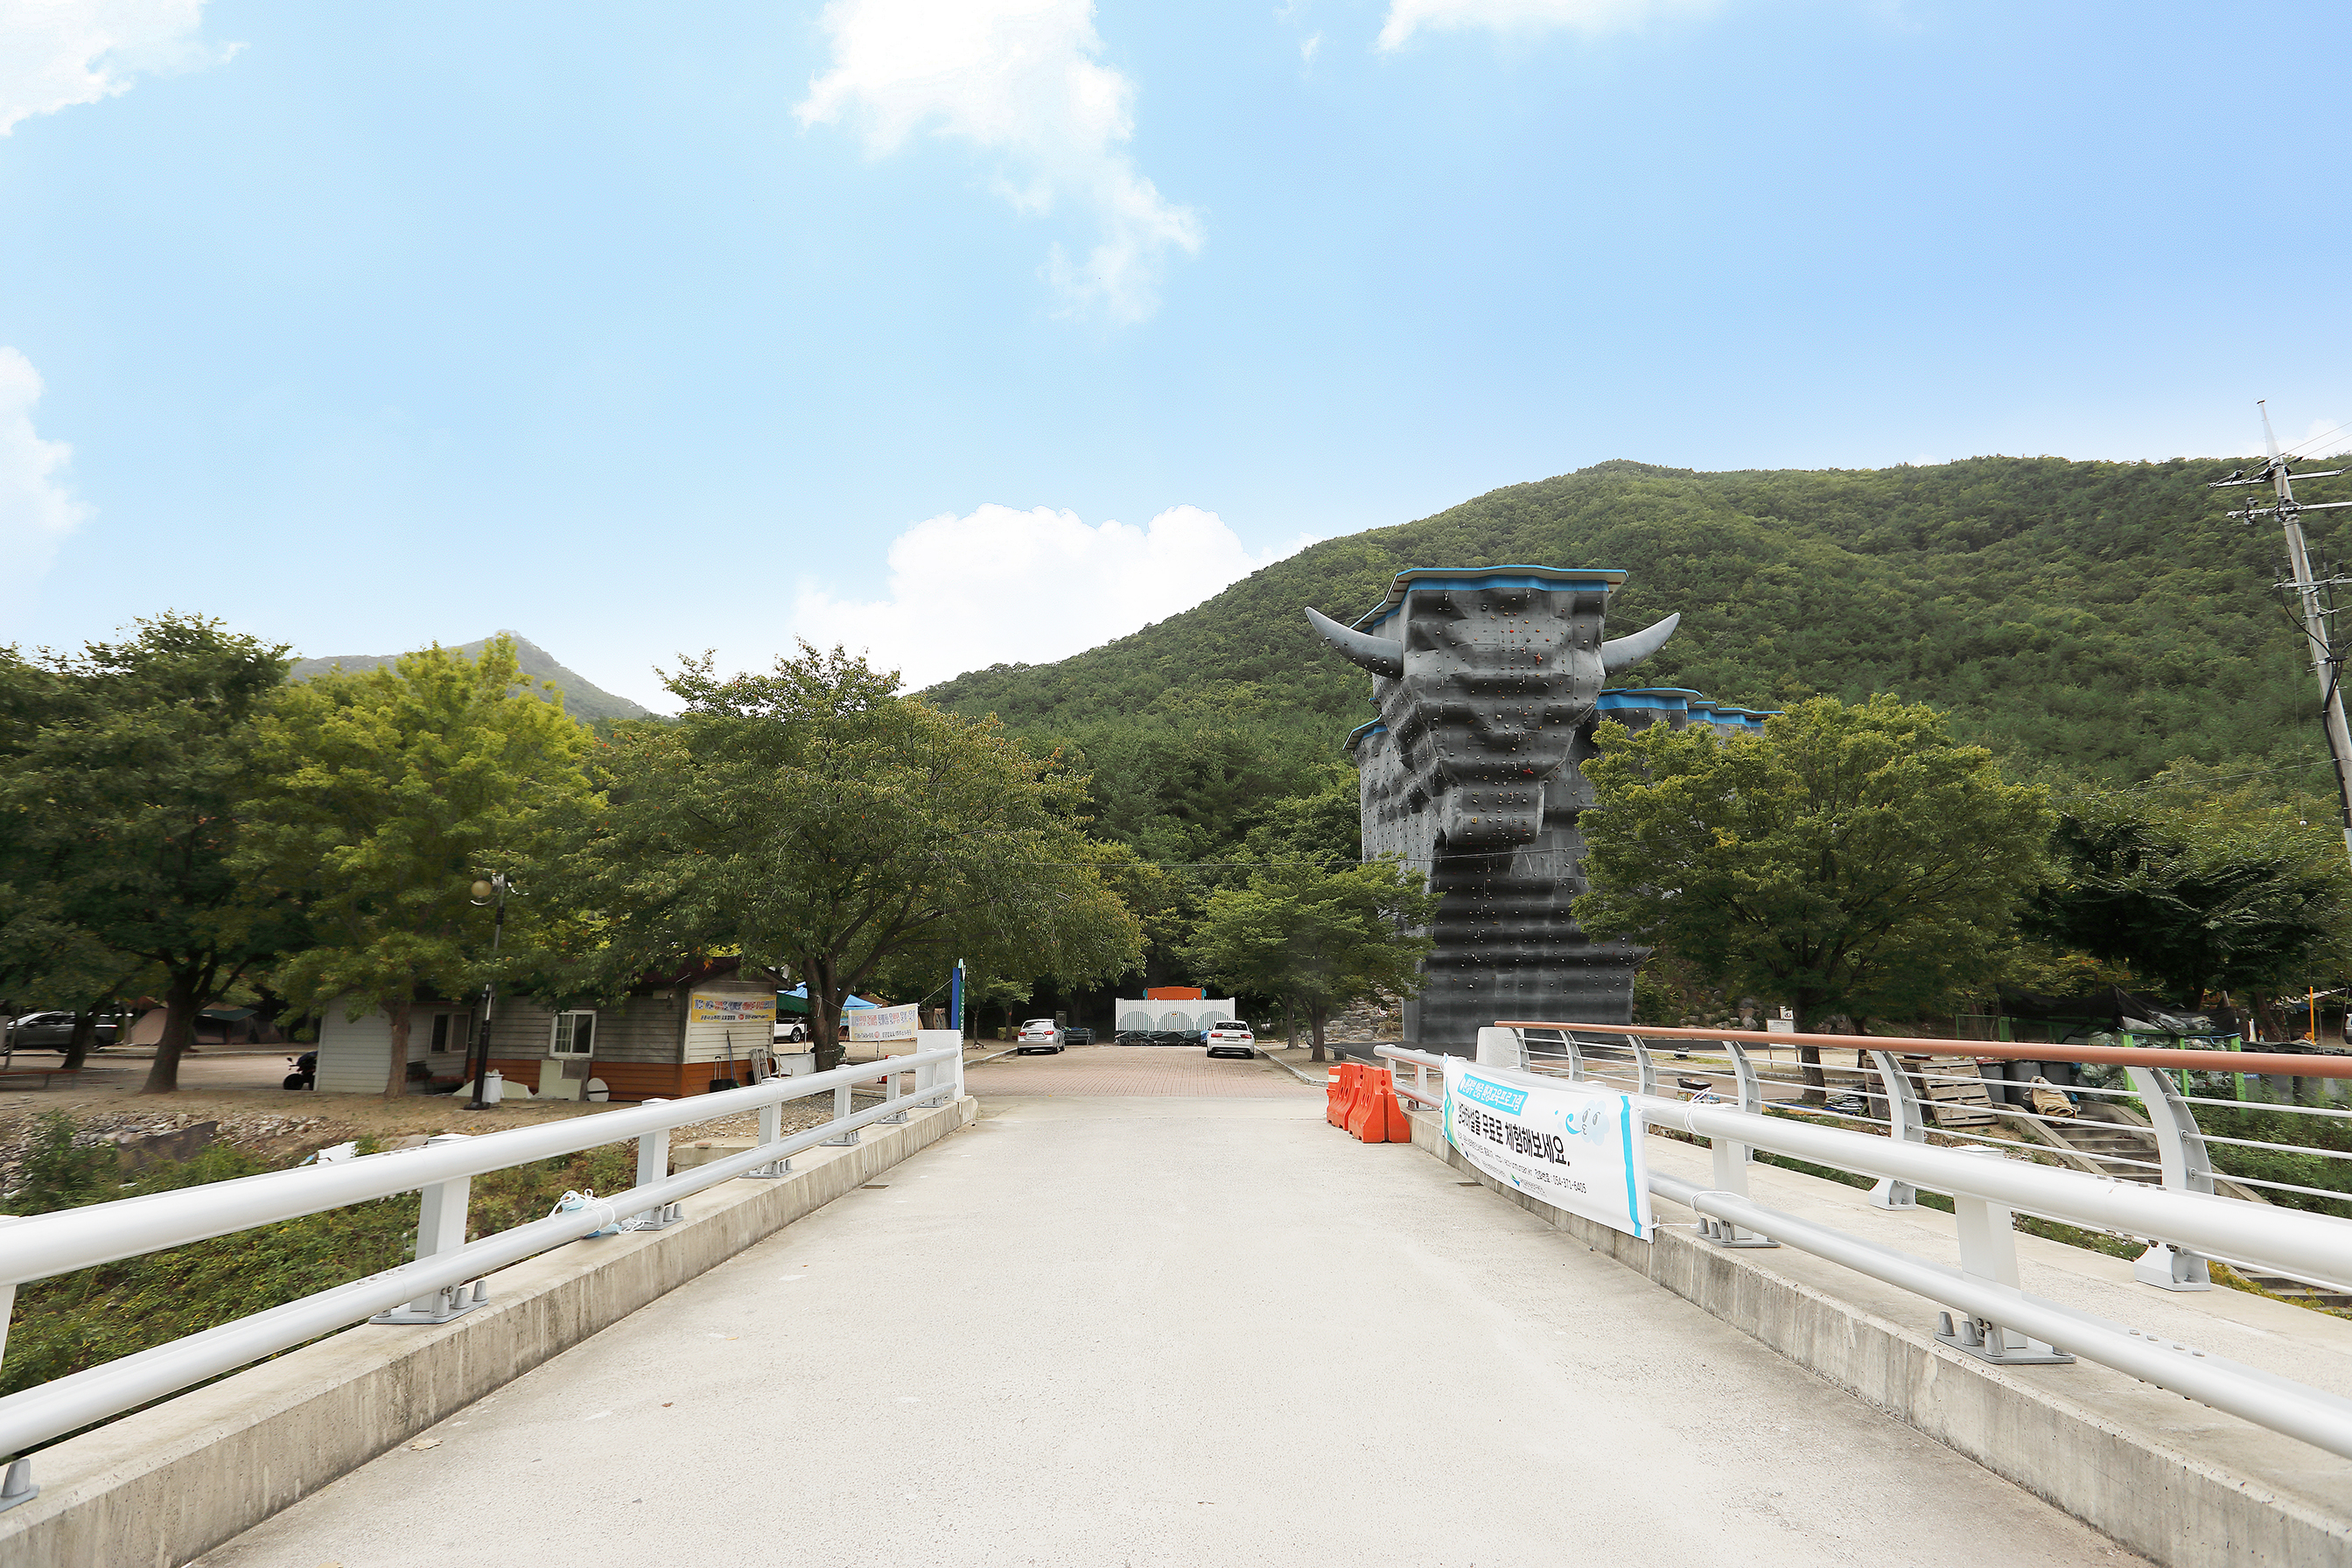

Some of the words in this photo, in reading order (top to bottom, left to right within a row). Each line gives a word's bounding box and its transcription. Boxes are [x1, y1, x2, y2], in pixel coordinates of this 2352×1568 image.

[1462, 1078, 1477, 1095] 환경부
[1474, 1082, 1485, 1099] 인증
[1482, 1113, 1504, 1145] 무료로
[1505, 1121, 1570, 1166] 체험해보세요.
[1553, 1175, 1586, 1194] 054-371-6405
